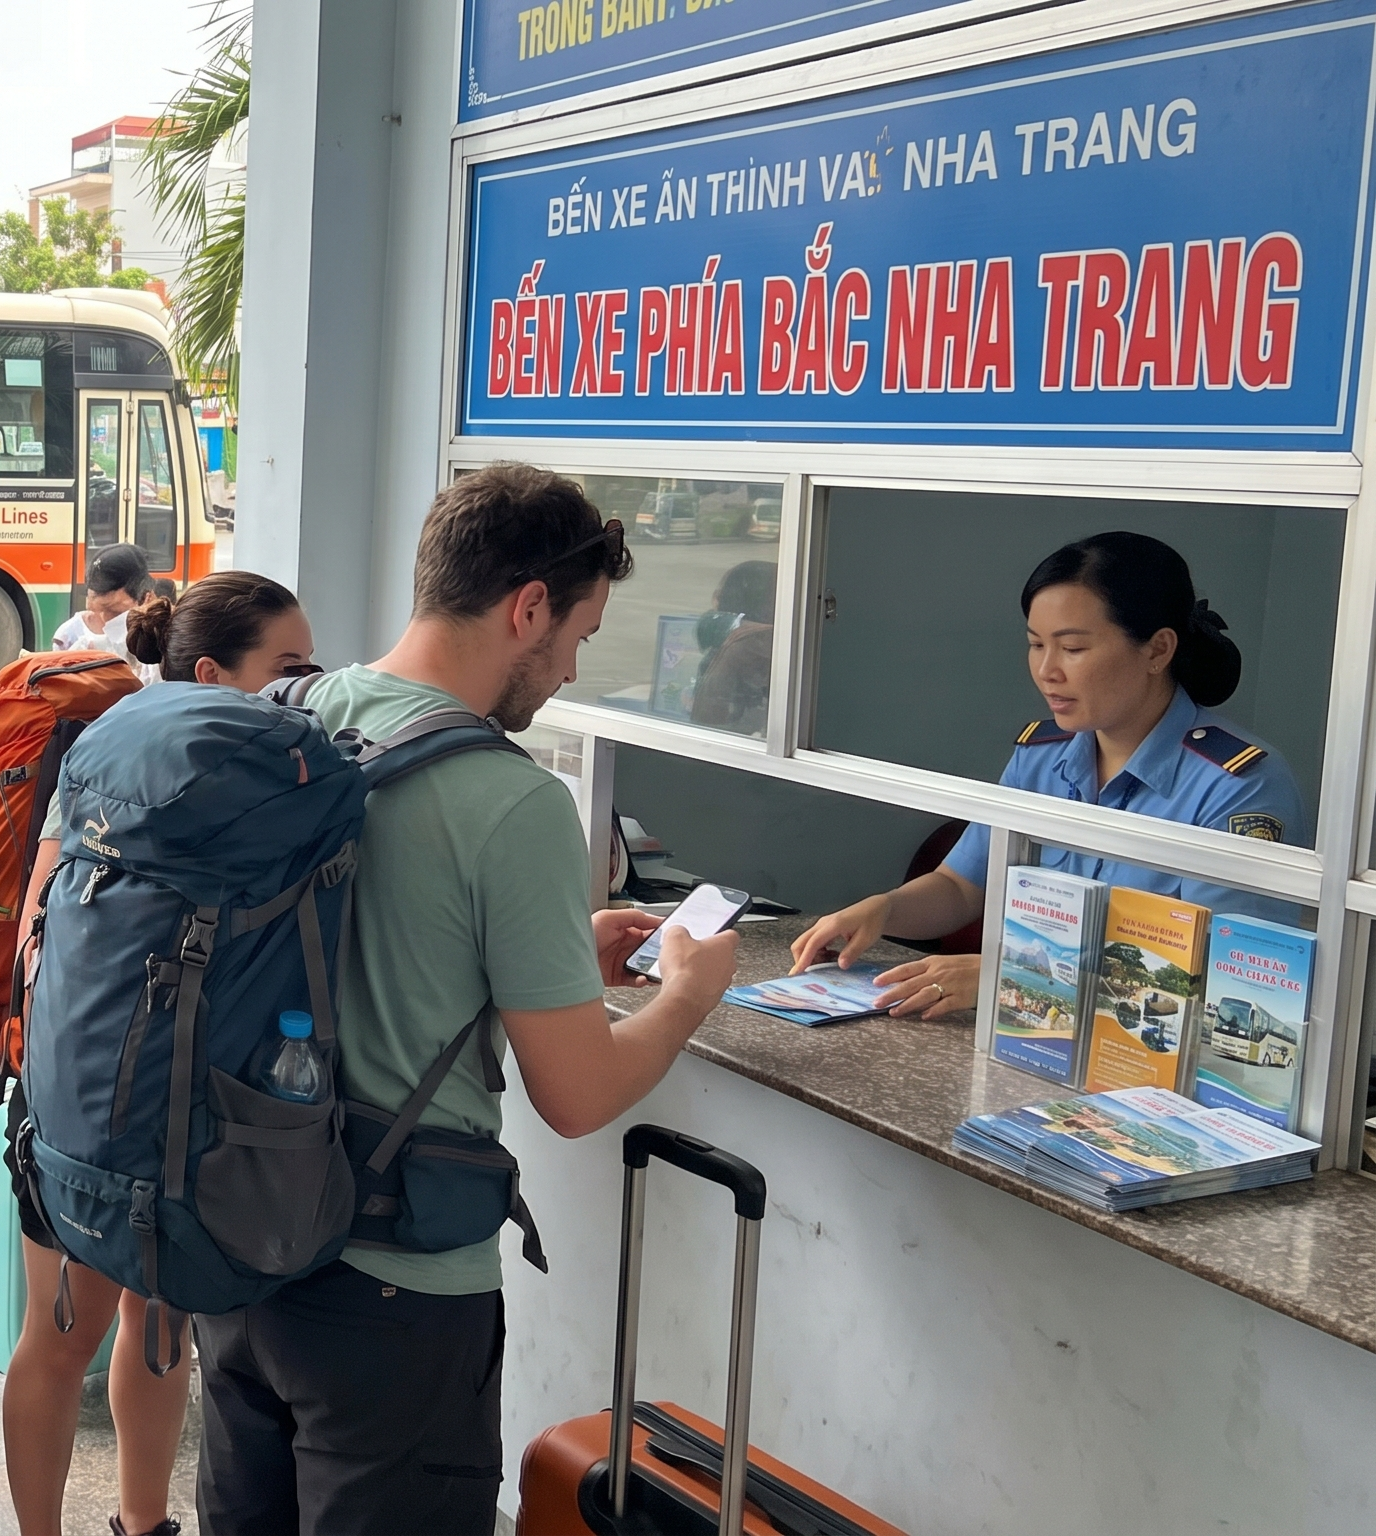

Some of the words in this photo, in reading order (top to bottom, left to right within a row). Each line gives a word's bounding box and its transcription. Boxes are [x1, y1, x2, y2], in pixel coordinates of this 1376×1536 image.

[518, 1, 593, 61] TRONG
[547, 176, 602, 237] BẾN
[609, 184, 648, 230] XE
[903, 130, 998, 192] NHA
[1014, 98, 1197, 176] TRANG
[487, 259, 565, 398] BẾN
[570, 289, 628, 397] XE
[635, 254, 745, 397] PHÍA
[757, 221, 871, 396] BẮC
[881, 257, 1015, 393] NHA
[1038, 231, 1303, 392] TRANG
[2, 507, 48, 524] Lines
